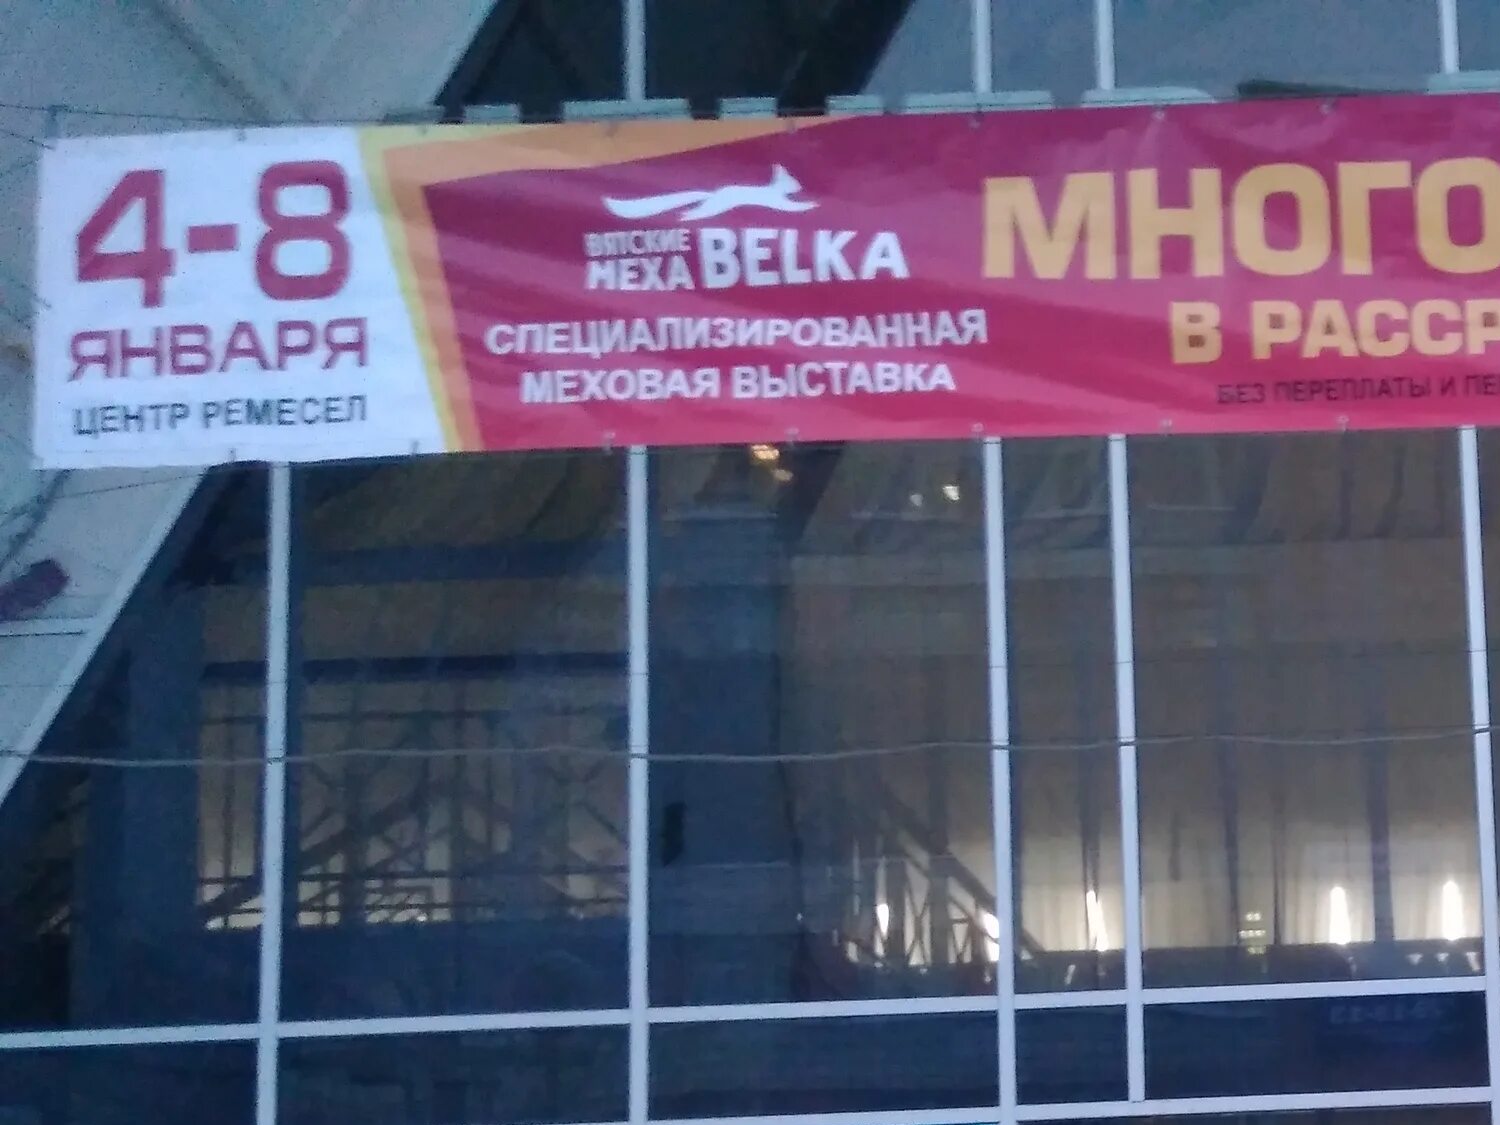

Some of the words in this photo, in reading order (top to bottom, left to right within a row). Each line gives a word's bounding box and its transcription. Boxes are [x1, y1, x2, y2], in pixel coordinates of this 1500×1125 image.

[76, 160, 351, 308] 4-8
[697, 227, 910, 288] BELKA
[584, 254, 695, 291] МЕХА
[68, 317, 368, 382] ЯНВАРЯ
[485, 308, 989, 358] СПЕЦИАЛИЗИРОВАННАЯ
[1170, 300, 1223, 365] В
[520, 366, 722, 404] МЕХОВАЯ
[731, 361, 957, 399] ВЫСТАВКА
[1217, 384, 1266, 404] БЕЗ
[1274, 376, 1434, 402] ПЕРЕПЛАТЫ
[1439, 375, 1460, 396] И
[73, 402, 190, 438] ЦЕНТР
[202, 394, 368, 429] РЕМЕСЕЛ
